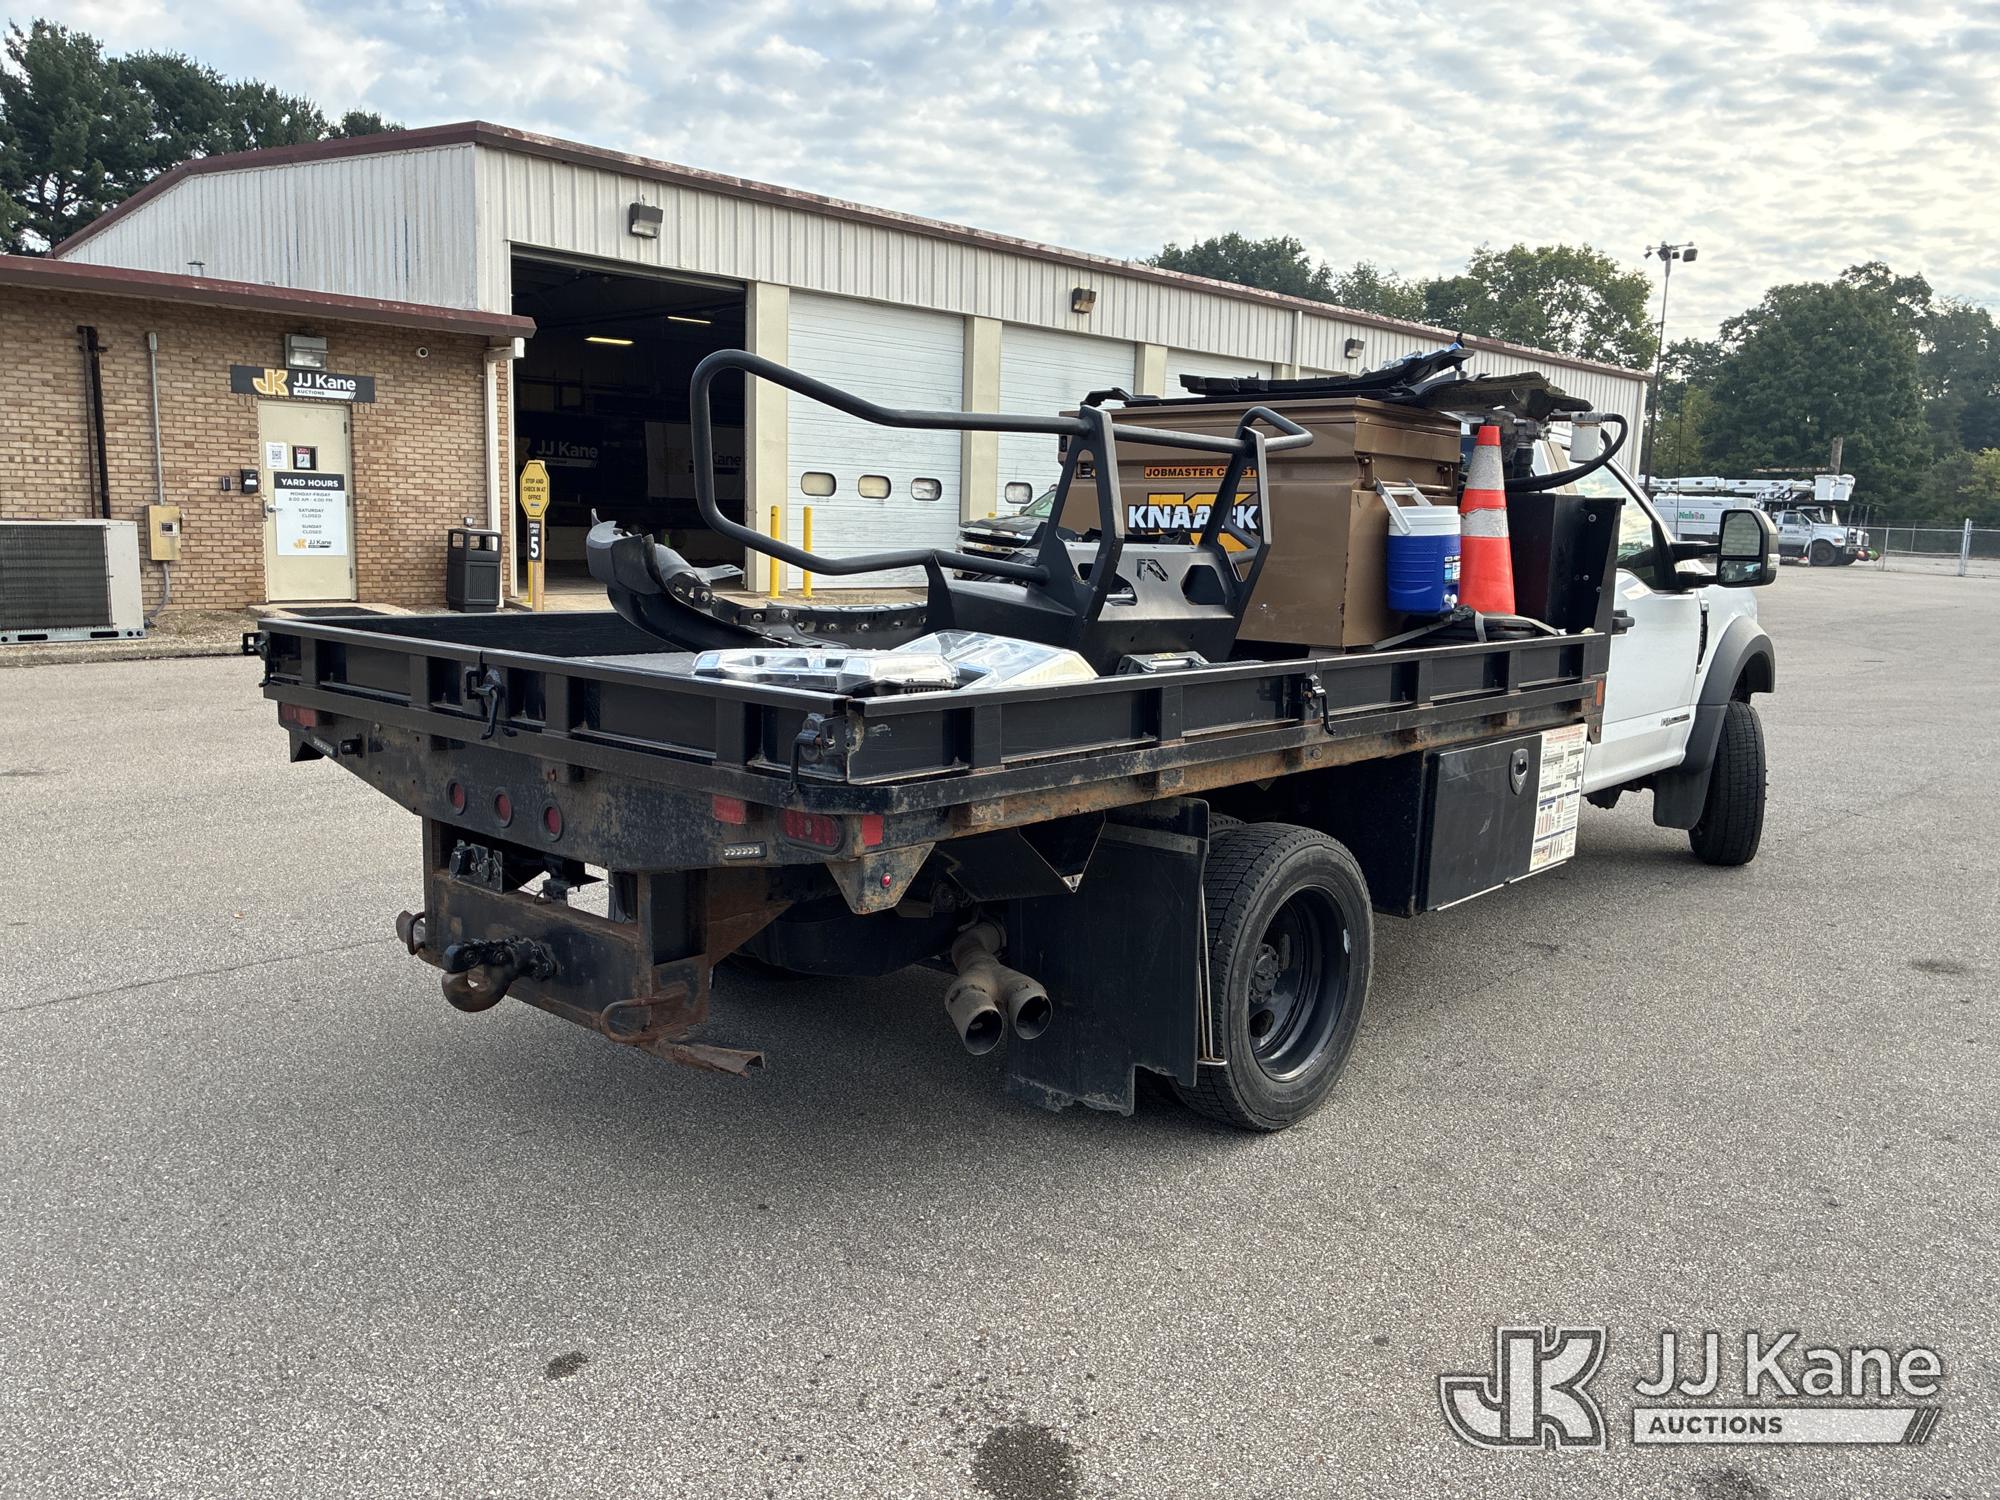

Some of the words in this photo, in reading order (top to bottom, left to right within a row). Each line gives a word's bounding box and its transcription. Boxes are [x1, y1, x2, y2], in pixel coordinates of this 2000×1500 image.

[293, 373, 312, 387] JJ
[316, 375, 356, 391] Kane
[537, 440, 555, 455] JJ
[559, 442, 598, 458] Kane
[1146, 467, 1213, 477] JOBMASTER
[281, 478, 306, 487] YARD
[1128, 505, 1259, 529] KNAAK
[530, 537, 539, 558] 5
